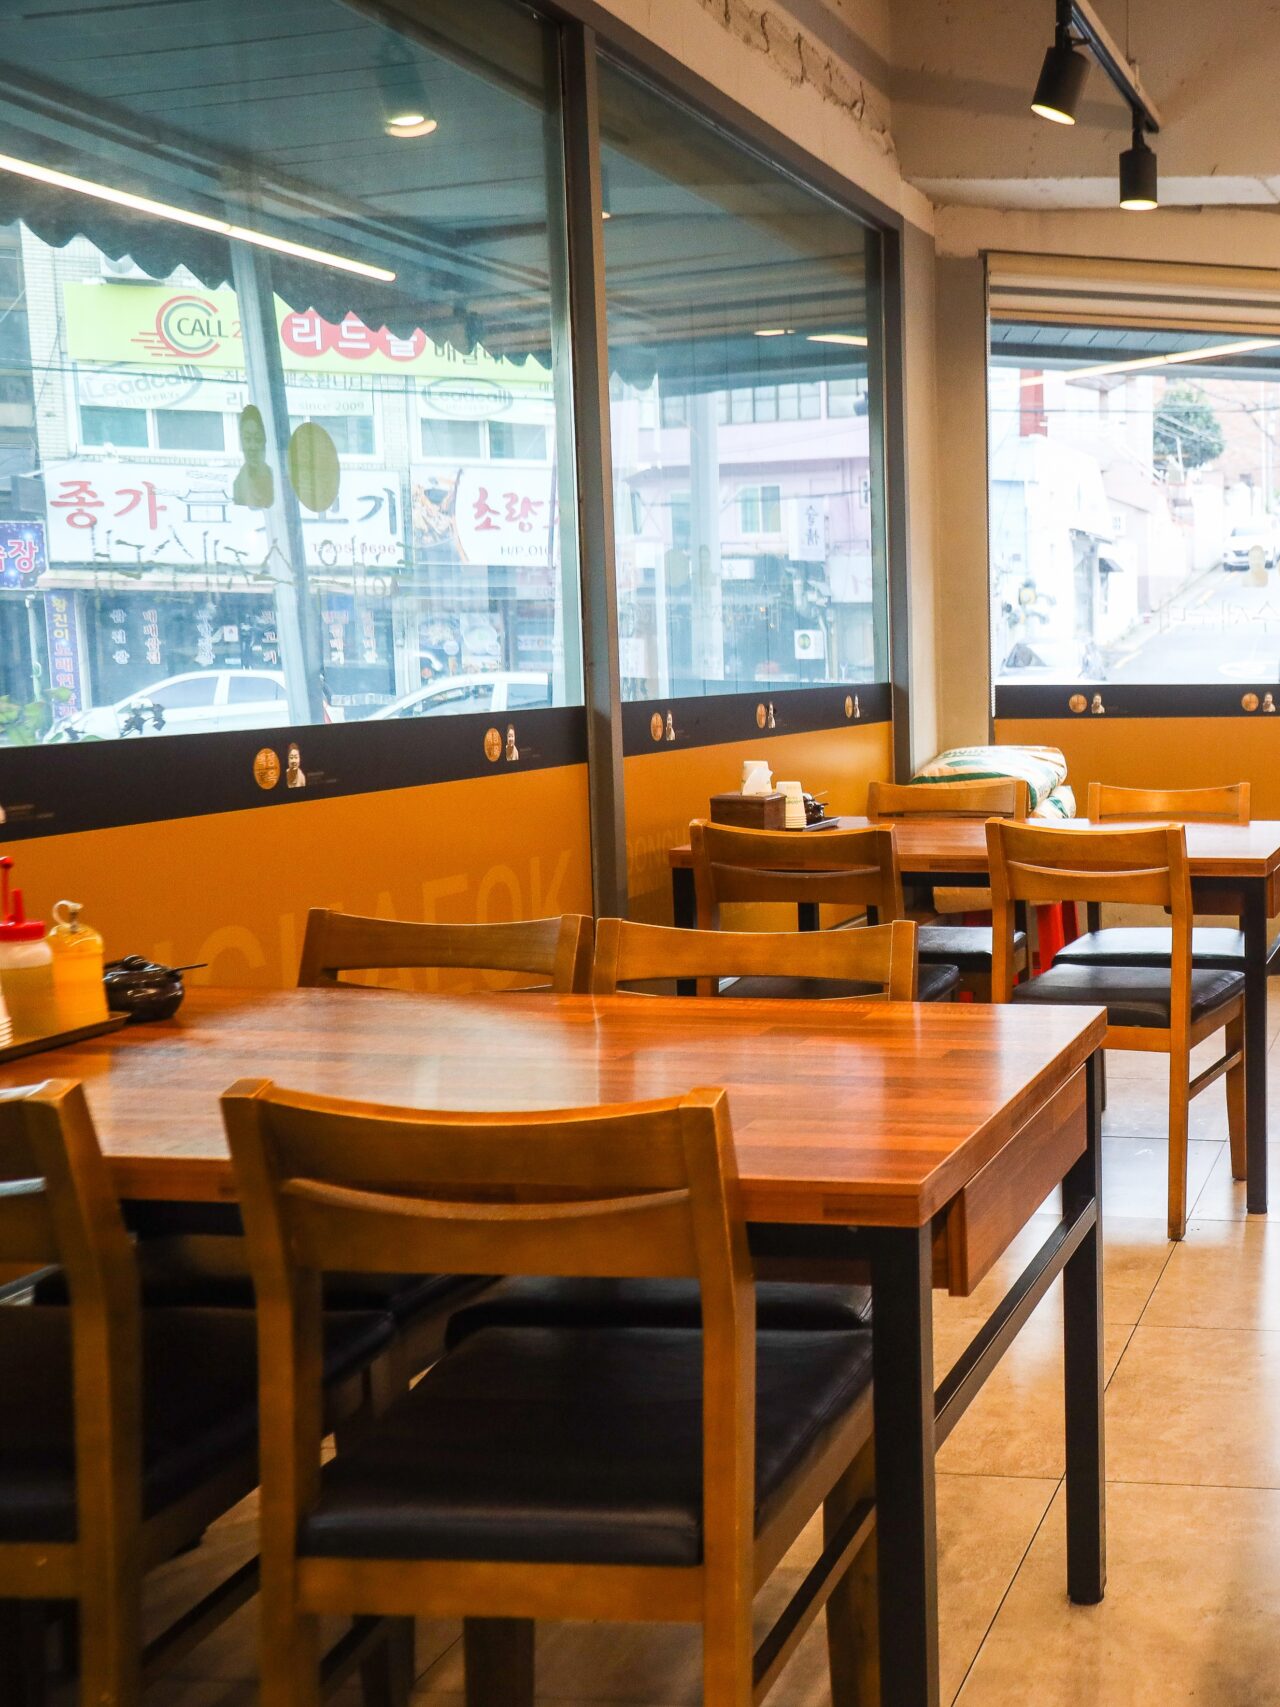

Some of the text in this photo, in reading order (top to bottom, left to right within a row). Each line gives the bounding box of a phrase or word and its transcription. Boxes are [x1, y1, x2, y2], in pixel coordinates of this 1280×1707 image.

[177, 317, 229, 338] CALL
[50, 480, 167, 530] 종가
[472, 487, 557, 532] 초량
